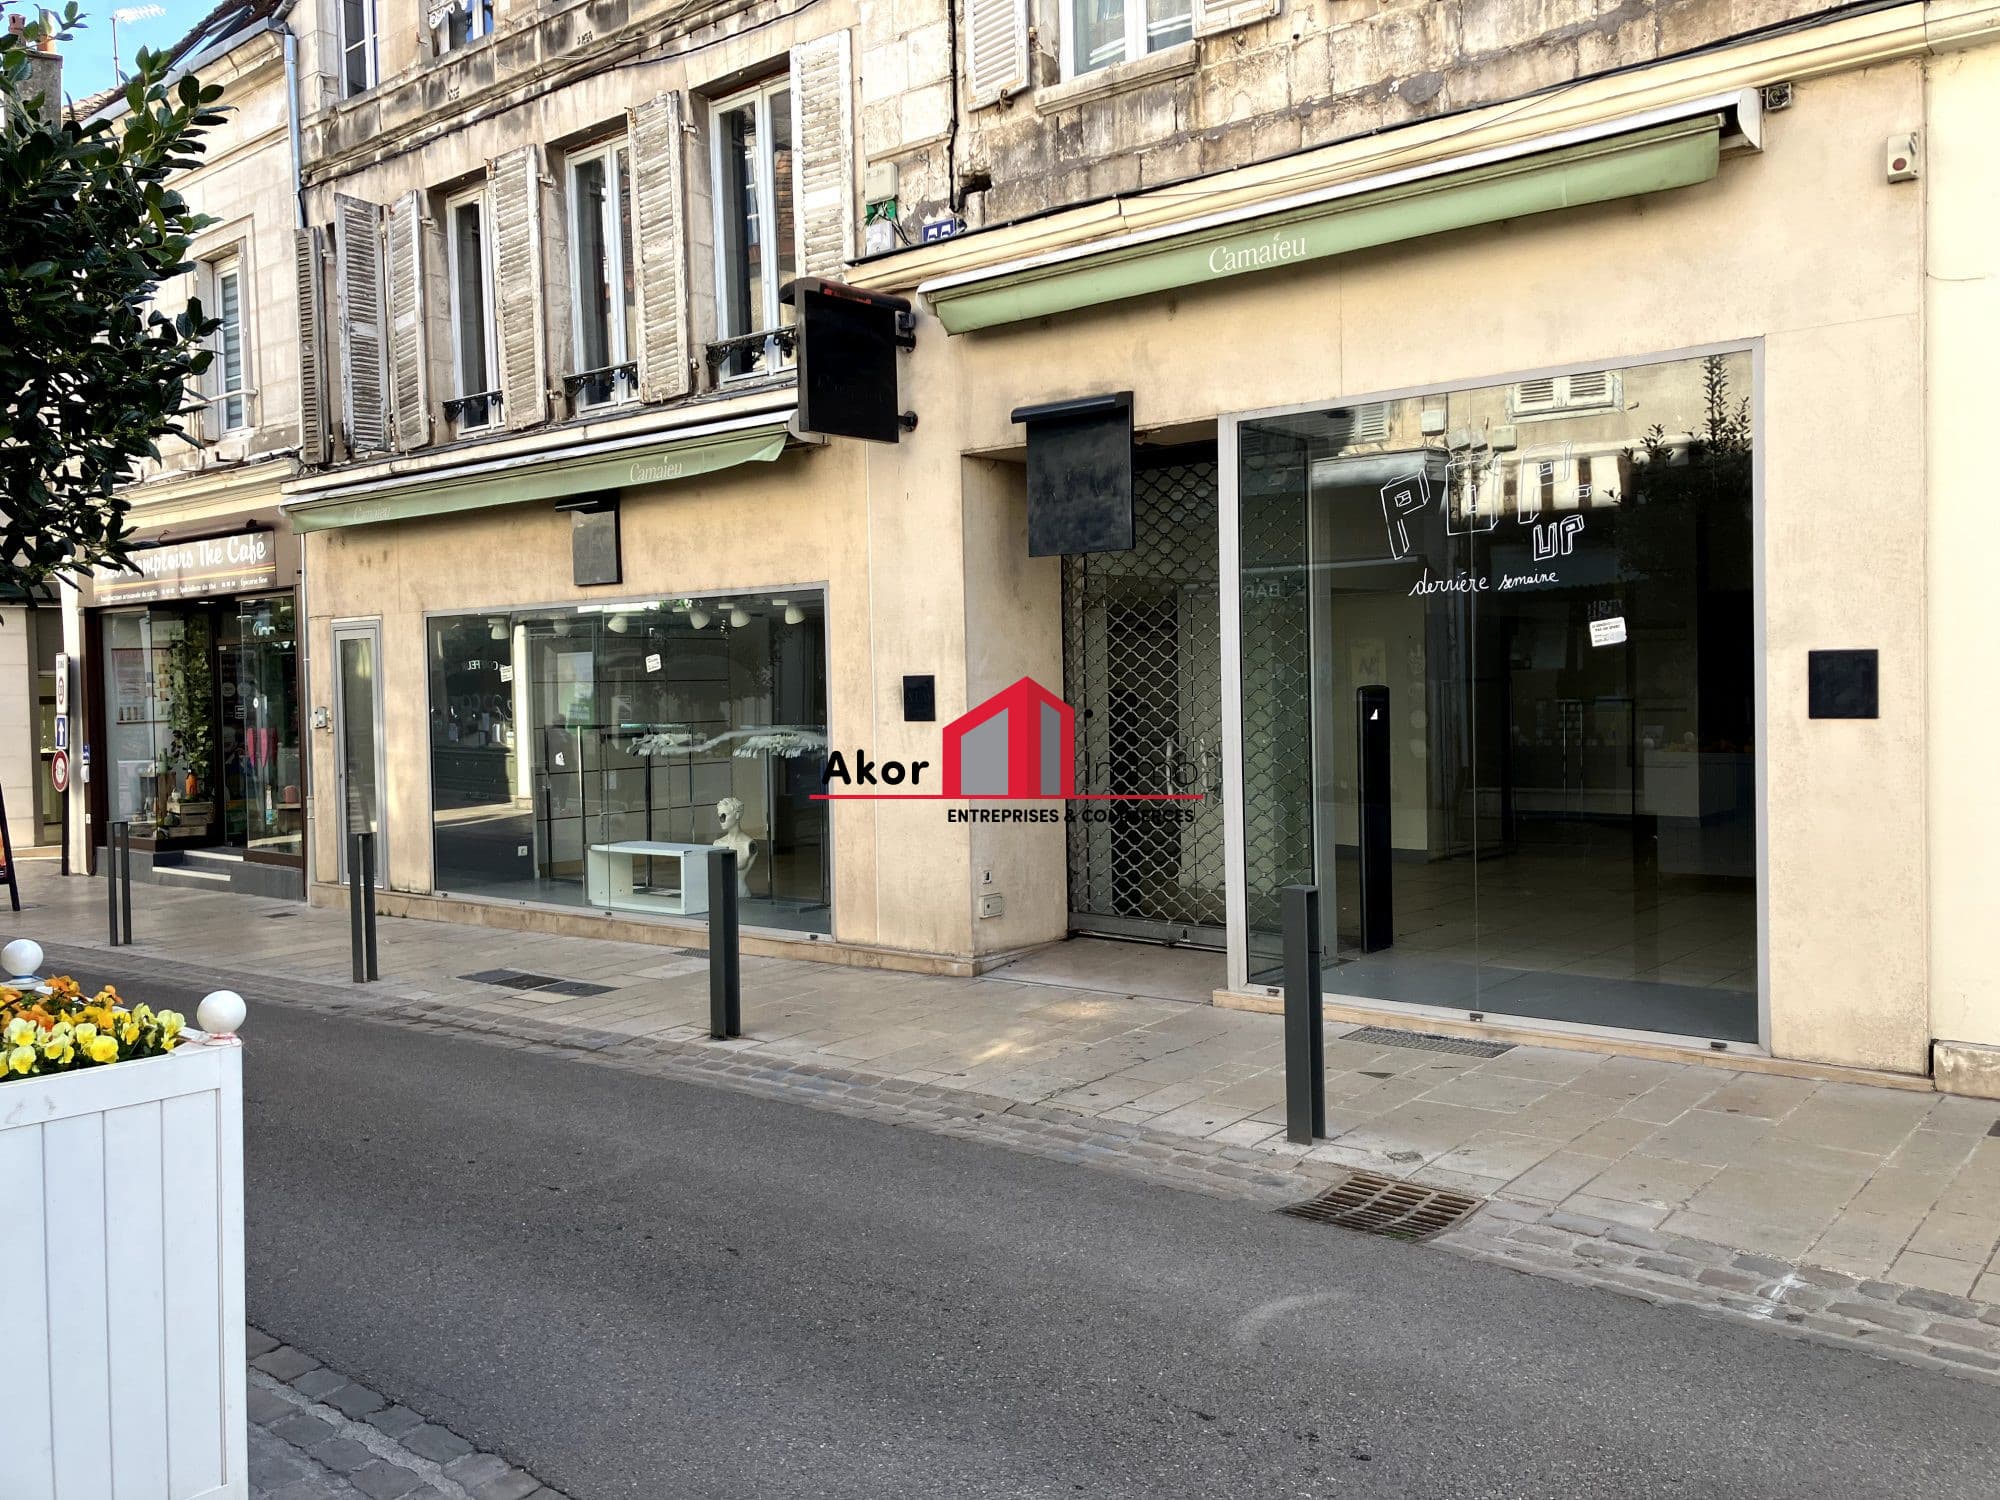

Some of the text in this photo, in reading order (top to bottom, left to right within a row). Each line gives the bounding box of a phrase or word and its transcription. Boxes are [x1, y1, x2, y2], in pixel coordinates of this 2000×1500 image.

[227, 533, 267, 565] Café
[1533, 514, 1585, 562] UP
[1498, 568, 1559, 591] semaine
